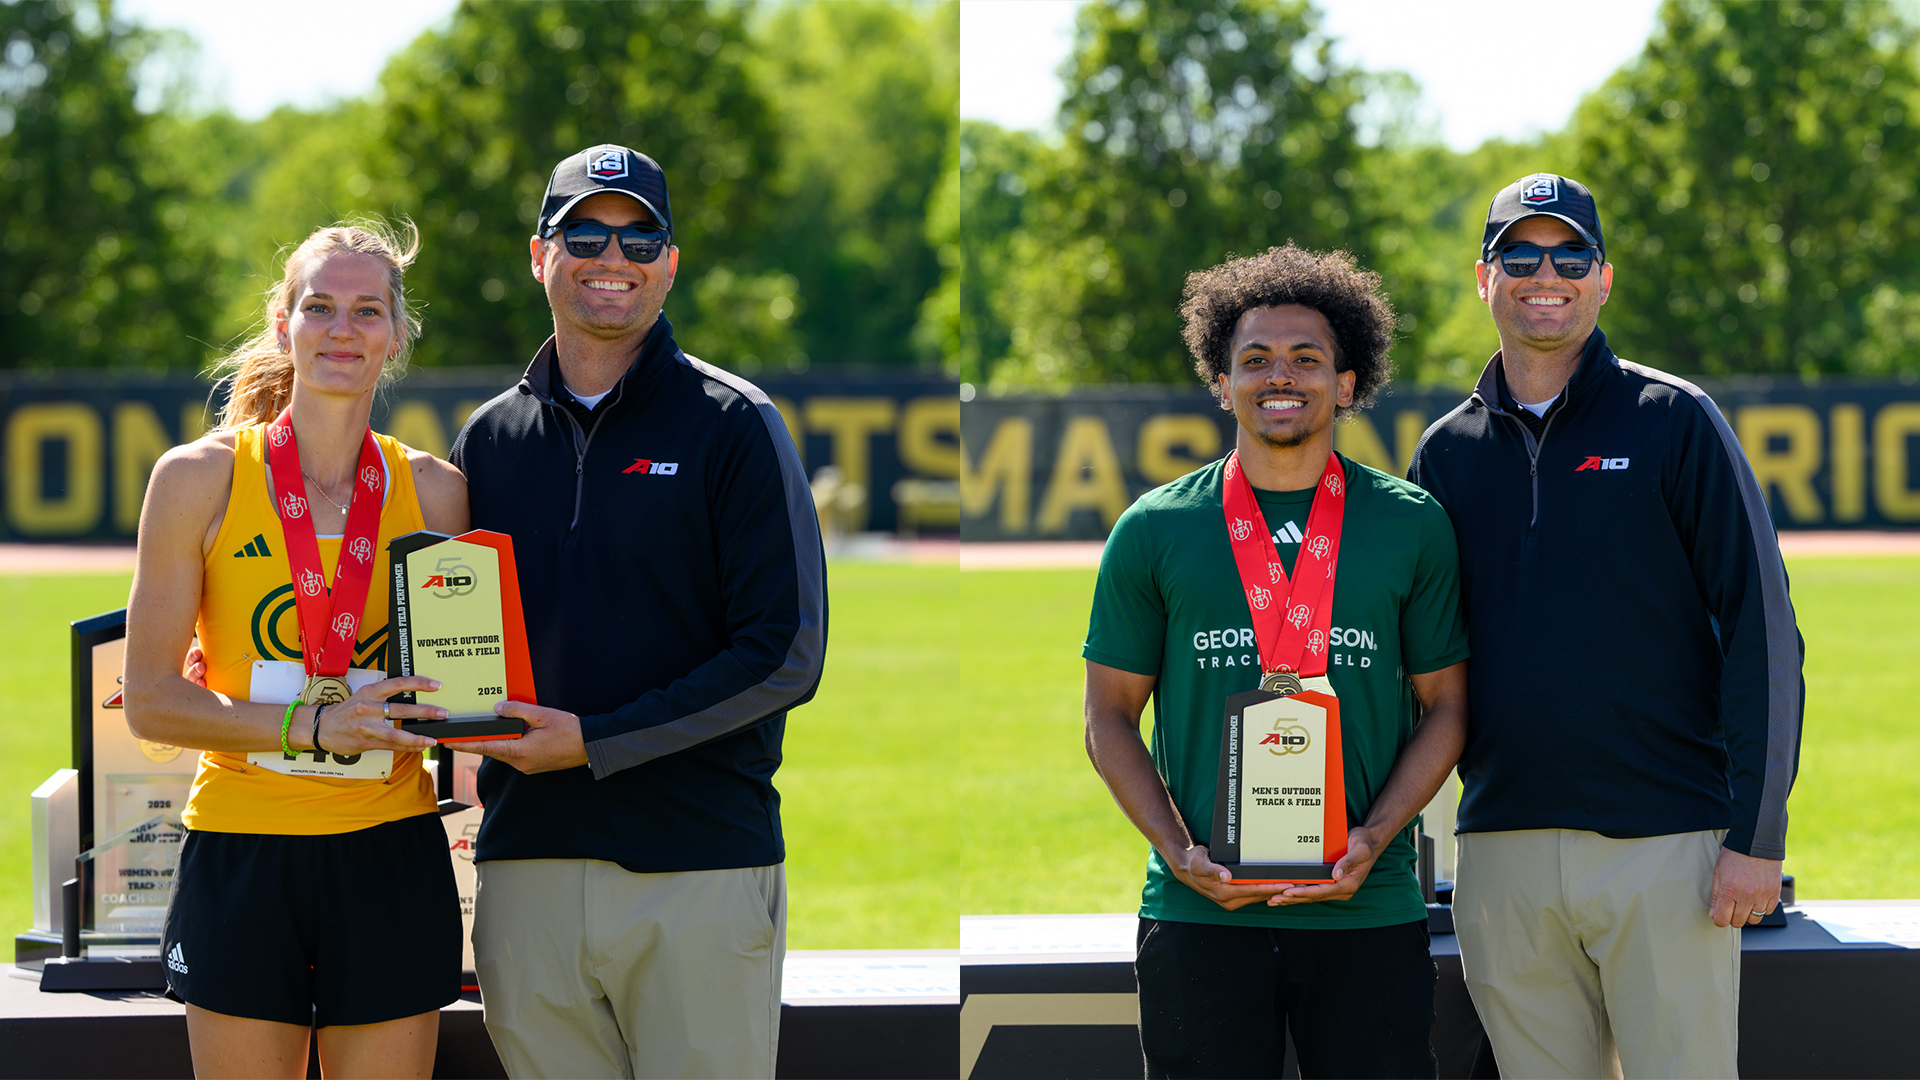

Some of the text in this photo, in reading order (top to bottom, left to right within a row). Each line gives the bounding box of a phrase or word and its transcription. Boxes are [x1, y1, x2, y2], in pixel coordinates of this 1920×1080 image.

[621, 458, 679, 476] A10
[1574, 456, 1630, 471] A10
[394, 563, 405, 606] PERFORMER
[421, 575, 472, 589] A10
[433, 556, 478, 599] 50
[397, 606, 407, 627] FIELD
[417, 635, 500, 647] WOMEN'S OUTDOOR
[1193, 627, 1258, 651] GEOR
[399, 628, 410, 677] OUTSTANDING
[436, 647, 500, 658] TRACK & FIELD
[1334, 653, 1371, 668] ELD
[477, 686, 503, 696] 2026
[1258, 733, 1305, 745] A10
[1269, 717, 1311, 756] 50
[1227, 715, 1238, 844] MOST OUTSTANDING TRACK PERFORMER
[1252, 787, 1321, 795] MEN'S OUTDOOR
[147, 800, 172, 809] 2026
[1256, 798, 1321, 806] TRACK & FIELD
[1297, 835, 1320, 843] 2026
[118, 868, 159, 877] WOMEN'S
[101, 893, 144, 904] COACH
